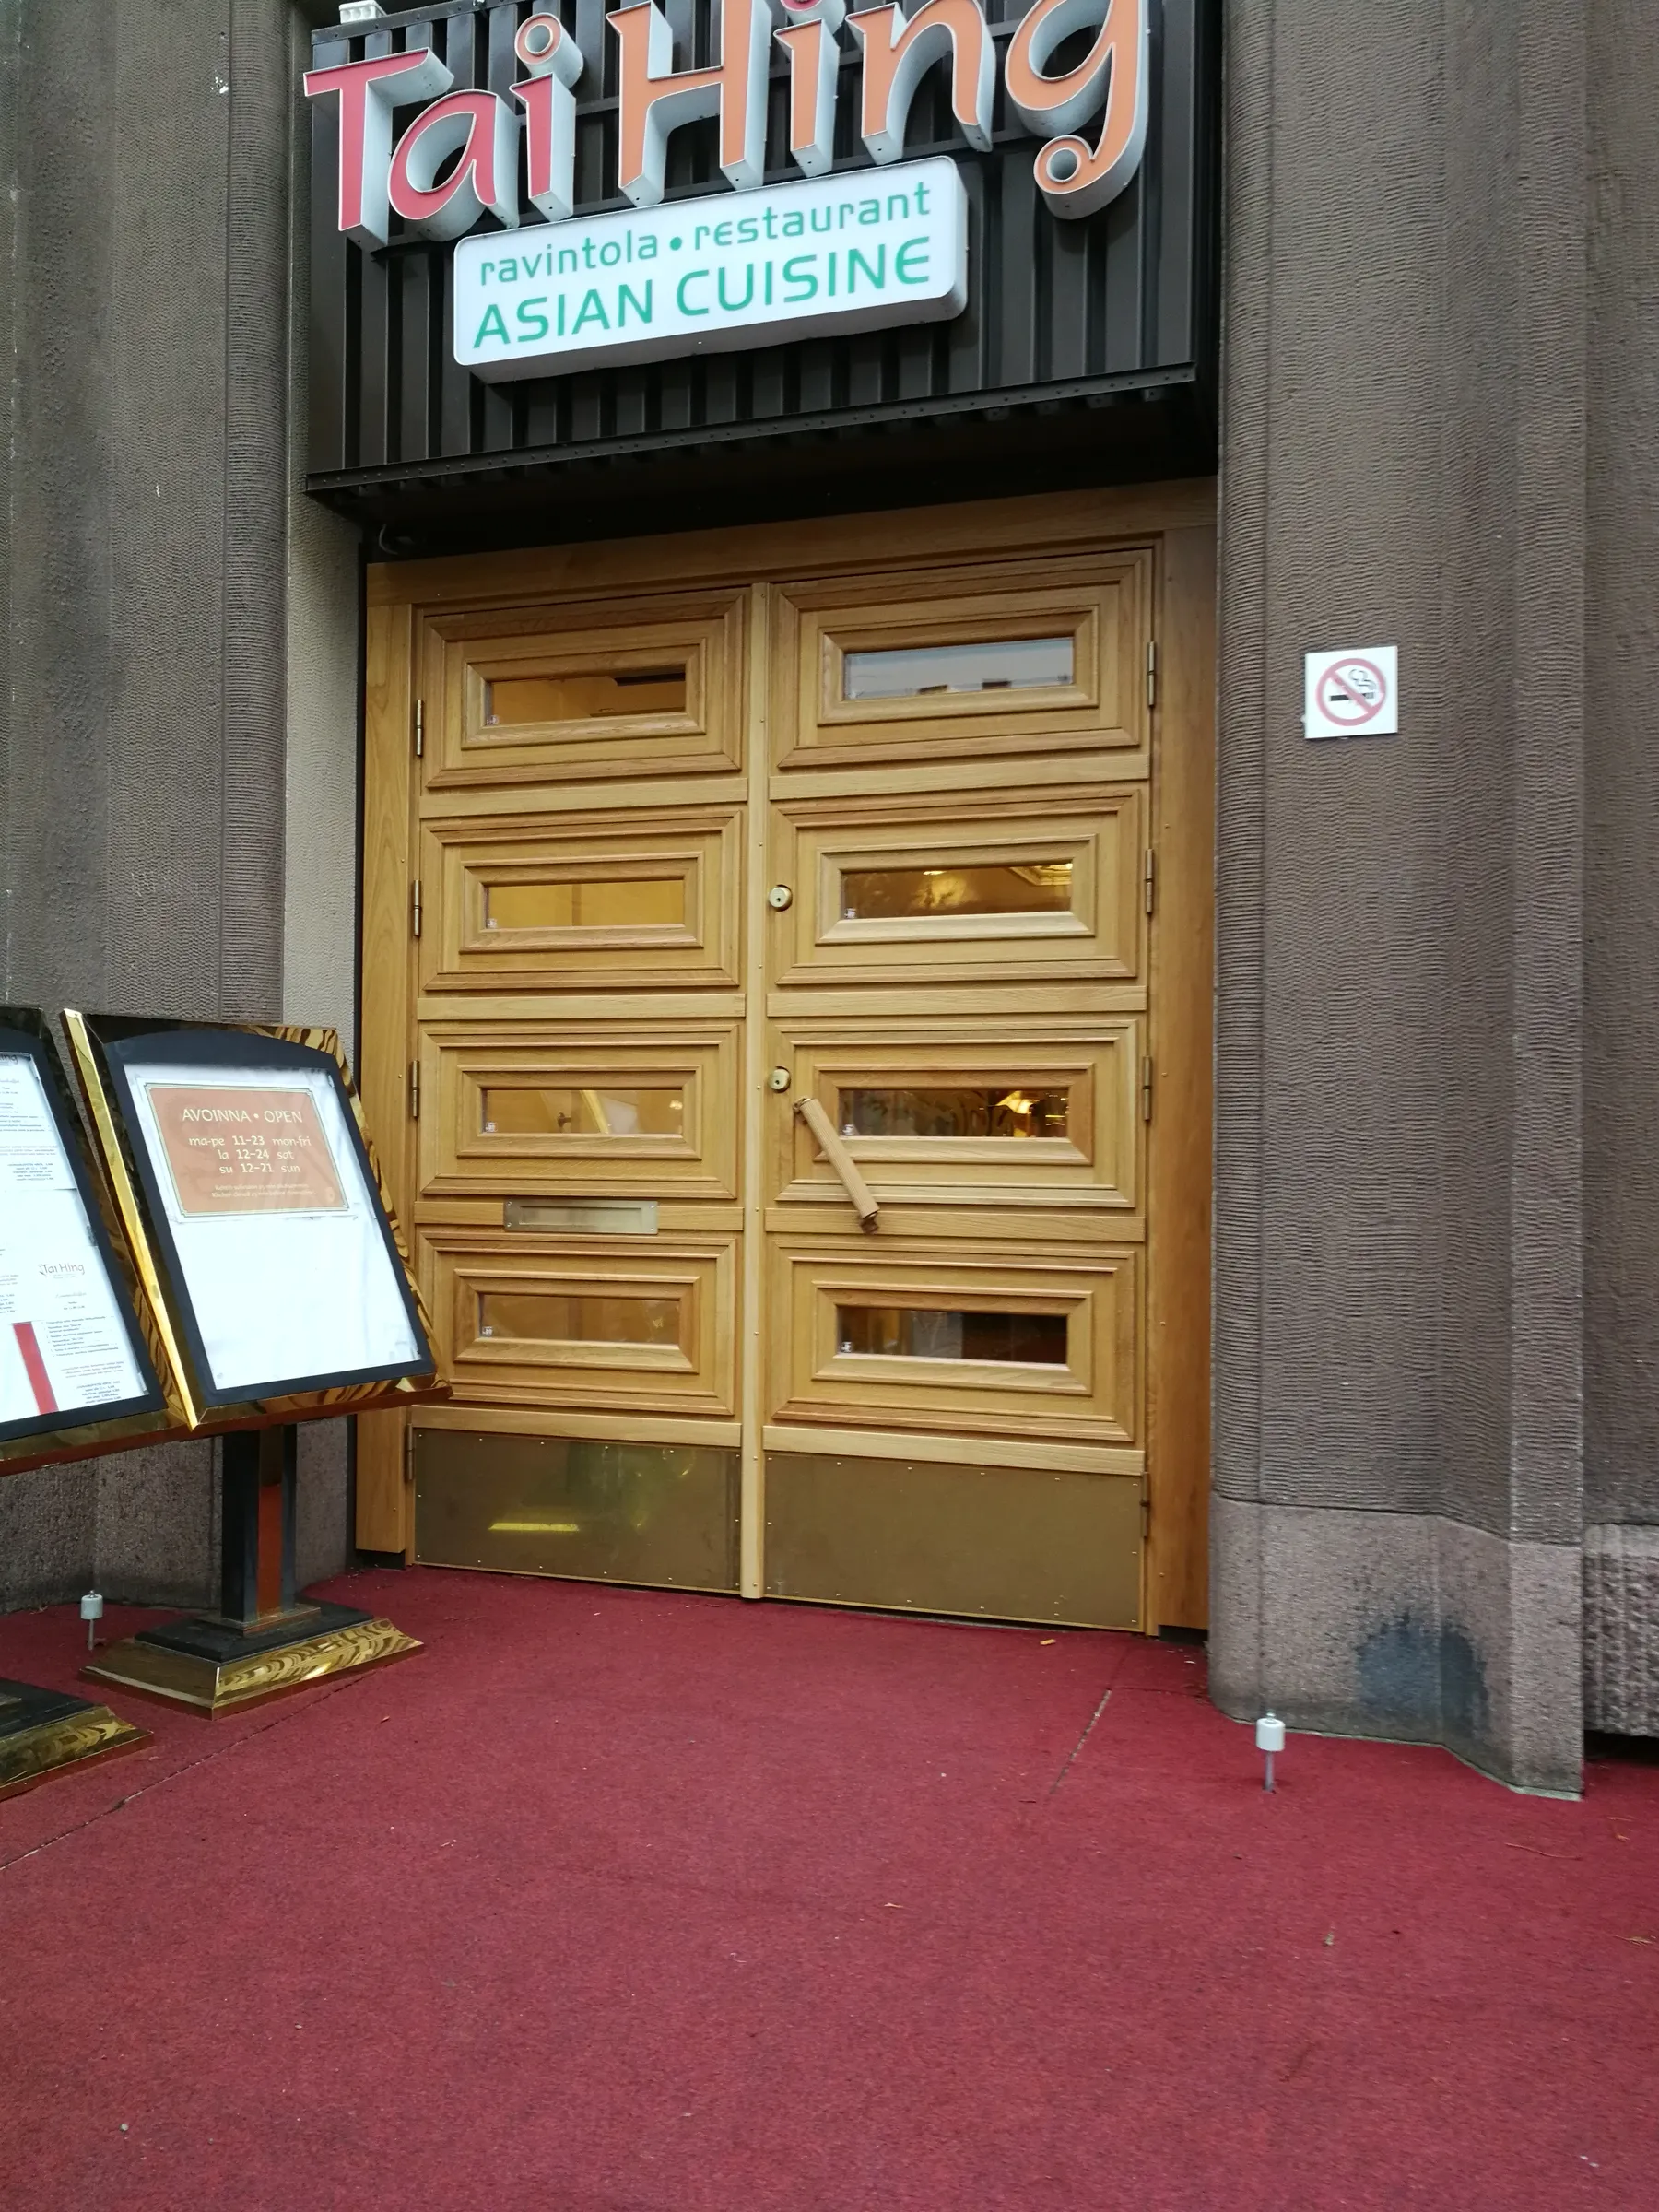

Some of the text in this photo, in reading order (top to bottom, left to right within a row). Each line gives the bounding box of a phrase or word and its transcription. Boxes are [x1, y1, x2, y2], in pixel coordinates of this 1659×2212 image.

[303, 0, 1147, 241] Tai Hing
[479, 181, 932, 287] ravintola restaurant
[473, 235, 932, 349] ASIAN CUISINE
[182, 1108, 303, 1124] AVOINNA OPEN
[188, 1135, 312, 1147] ma-pe 11-23 mon-fri
[218, 1149, 294, 1159] la 12-24 sat
[219, 1163, 301, 1174] su 12-21 sun
[41, 1263, 85, 1276] Tai Hing
